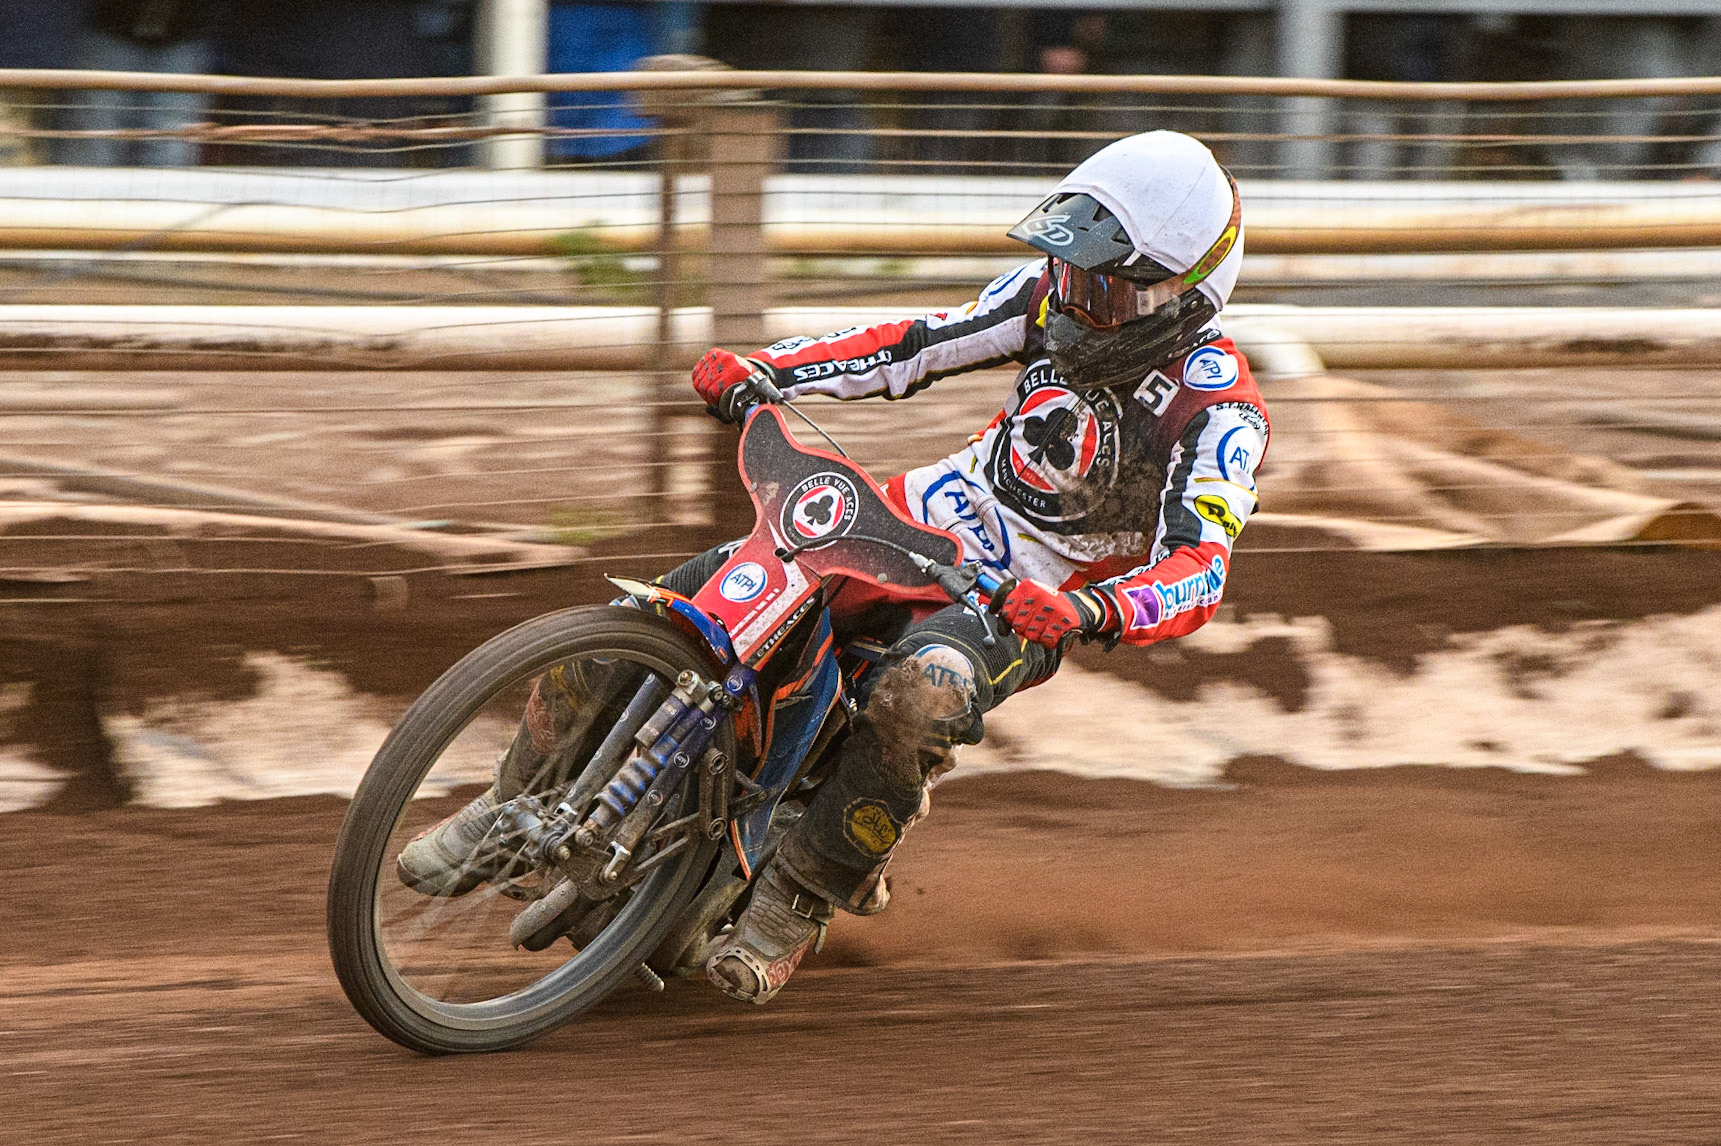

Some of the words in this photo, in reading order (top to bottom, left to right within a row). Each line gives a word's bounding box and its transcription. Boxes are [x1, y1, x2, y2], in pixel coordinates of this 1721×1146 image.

[1140, 374, 1173, 412] 5
[802, 476, 831, 492] BELLE
[834, 478, 851, 495] VUE
[844, 496, 855, 521] ACES
[730, 572, 757, 592] ATPI
